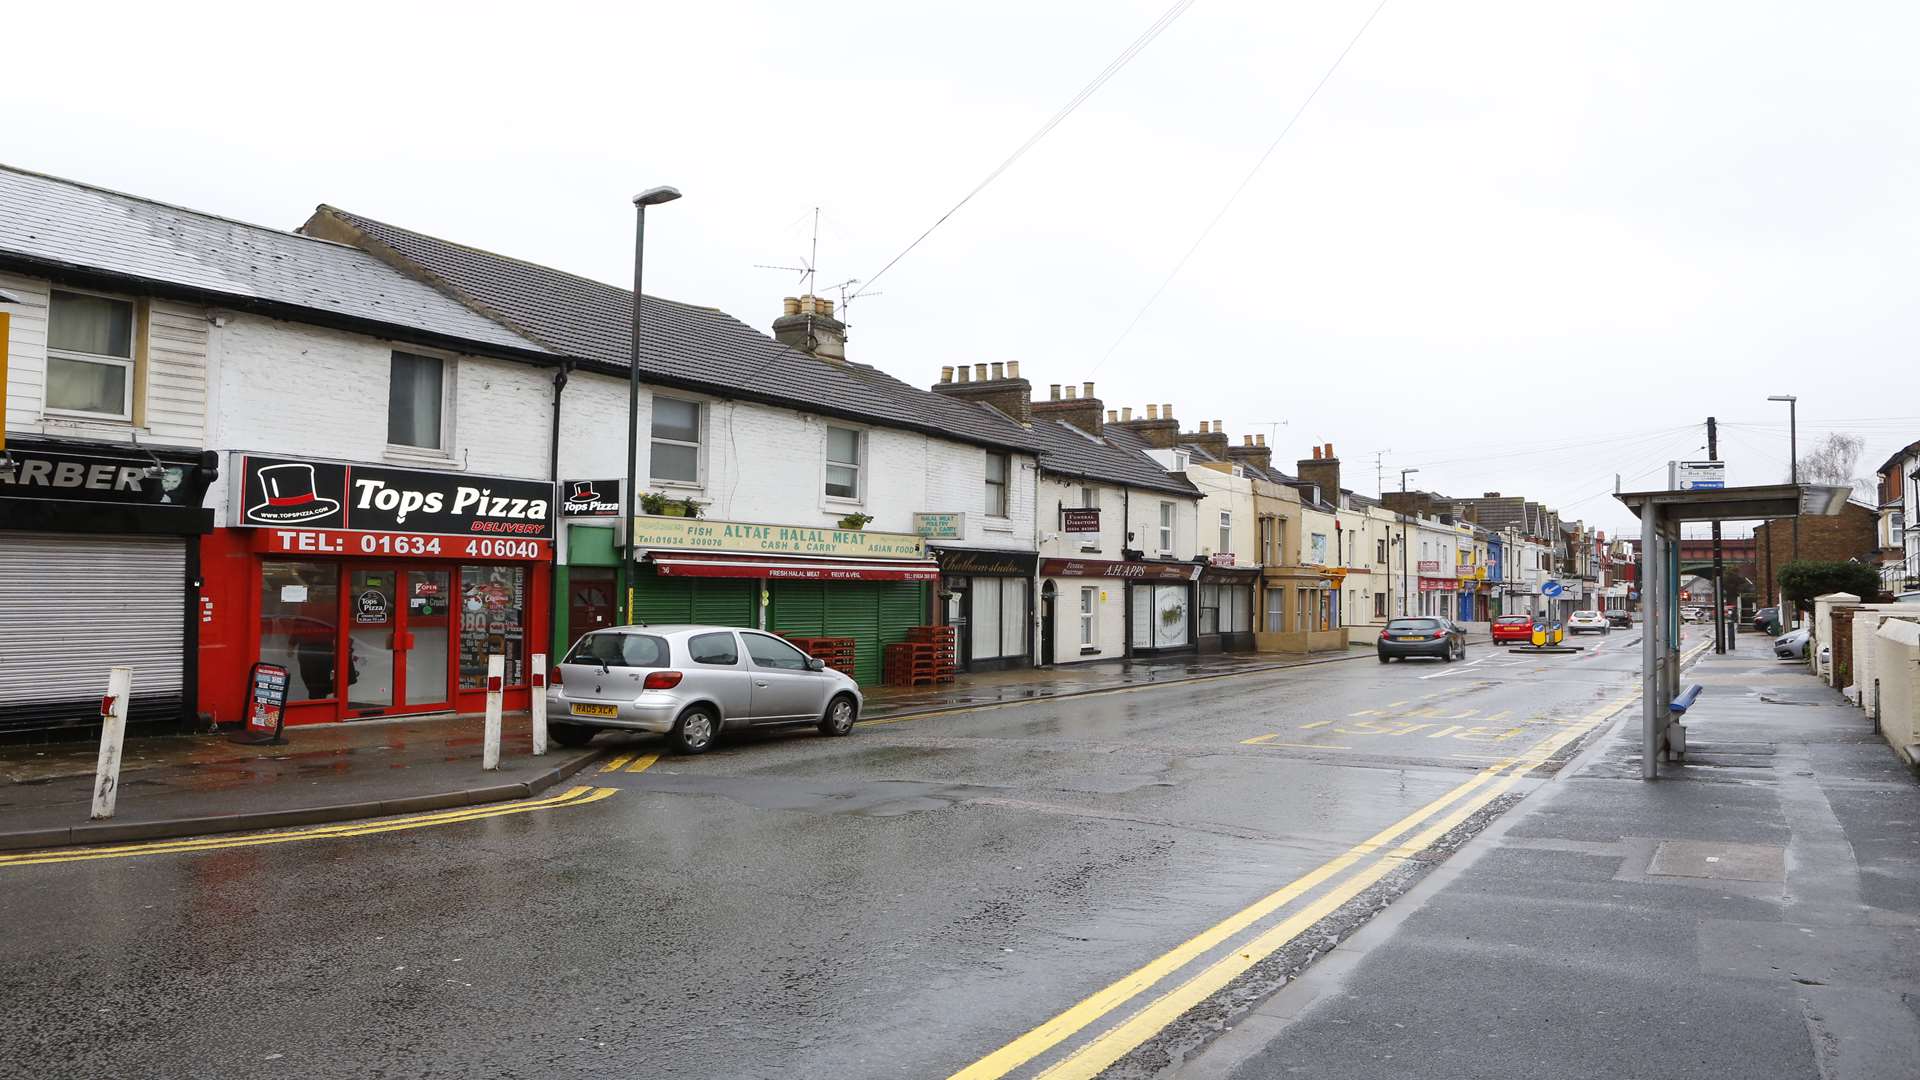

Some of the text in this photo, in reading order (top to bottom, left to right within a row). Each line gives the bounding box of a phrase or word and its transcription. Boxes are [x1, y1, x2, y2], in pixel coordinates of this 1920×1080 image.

[355, 479, 548, 525] Tops Pizza
[564, 501, 588, 515] Tops
[589, 501, 619, 511] Pizza
[260, 506, 329, 519] WWW.TOPSPIZZA.COM
[470, 520, 545, 534] DELIVERY
[687, 526, 713, 536] FISH
[724, 525, 771, 539] ALTAF
[780, 528, 825, 543] HALAL
[833, 532, 866, 545] MEAT
[277, 531, 538, 559] TEL: 01634 406040
[761, 540, 788, 549] CASH
[794, 542, 800, 550] &
[806, 543, 837, 552] CARRY
[867, 544, 892, 553] ASIAN
[769, 569, 787, 577] FRESH
[788, 570, 806, 578] HALAL
[364, 604, 383, 612] Pizza
[575, 705, 596, 714] RA05
